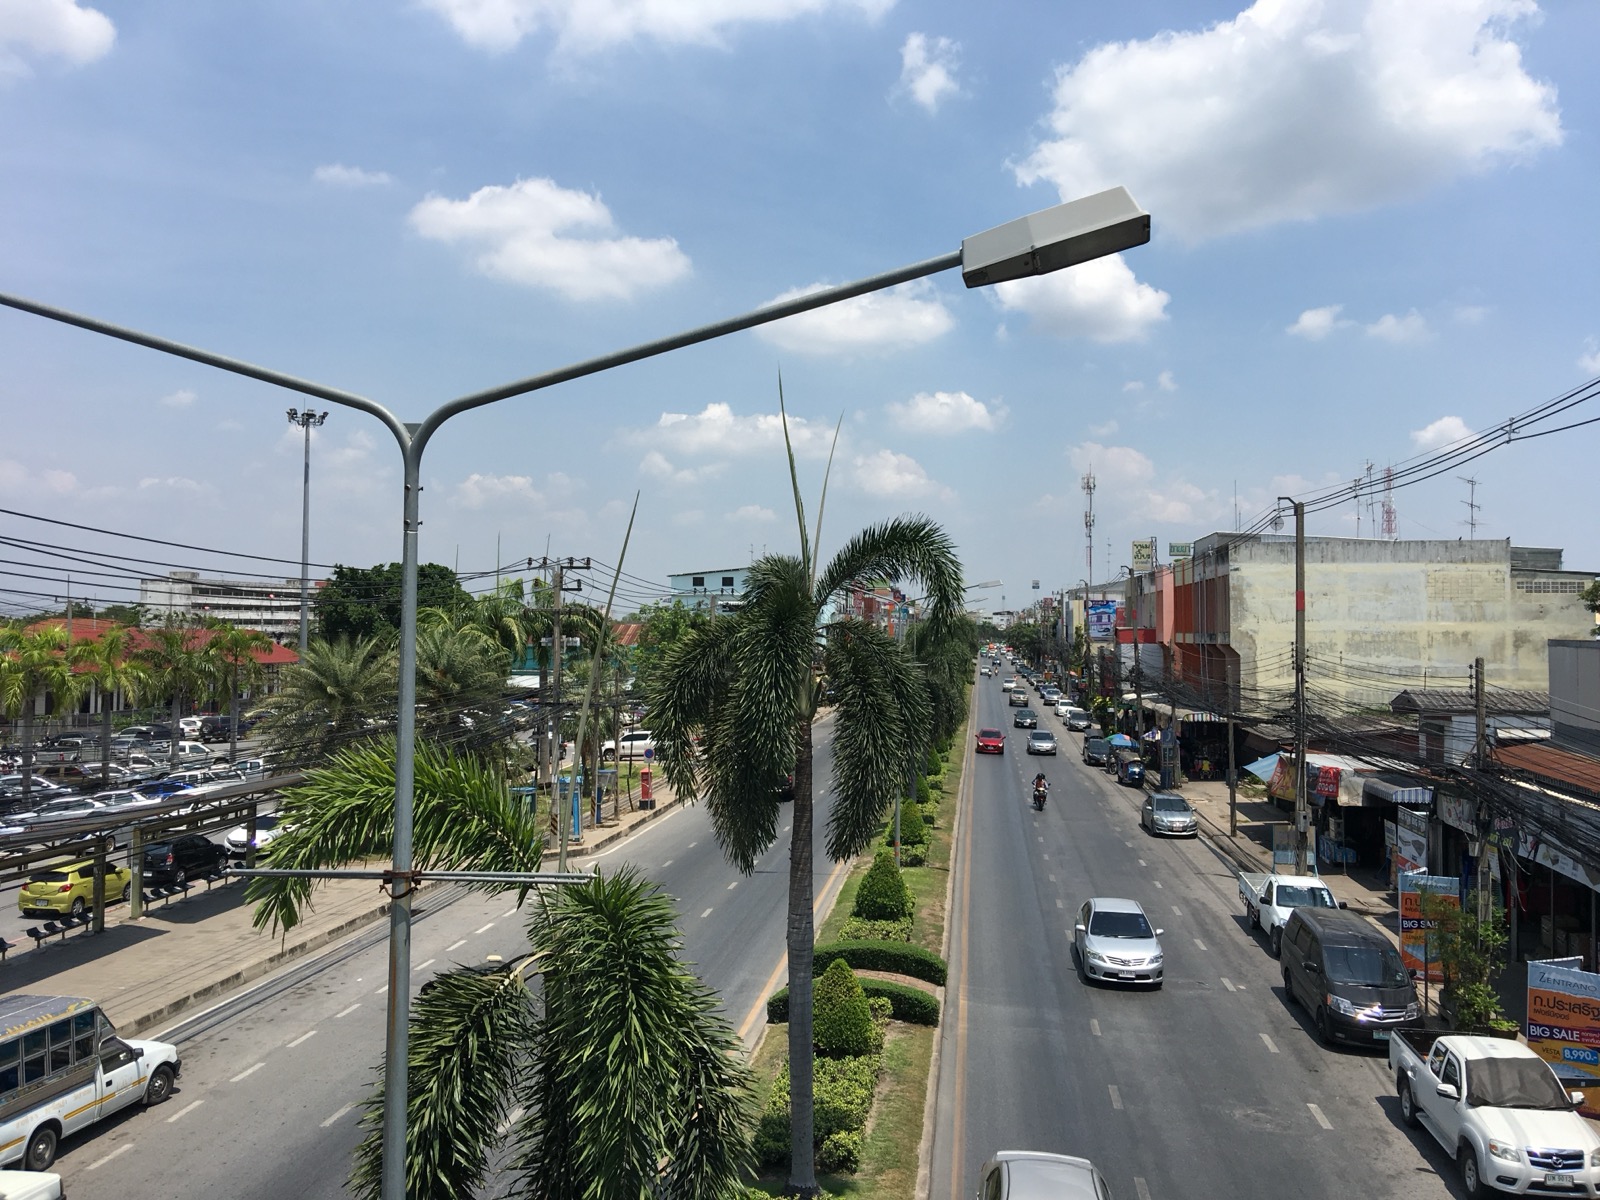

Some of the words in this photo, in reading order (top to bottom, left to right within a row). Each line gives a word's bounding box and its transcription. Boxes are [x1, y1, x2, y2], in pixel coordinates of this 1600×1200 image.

[1539, 972, 1597, 992] ZENTRANO
[1530, 1025, 1550, 1037] BIG
[1553, 1028, 1580, 1041] SALE
[1542, 1047, 1560, 1056] VESTA
[1564, 1048, 1598, 1061] 8,990.-
